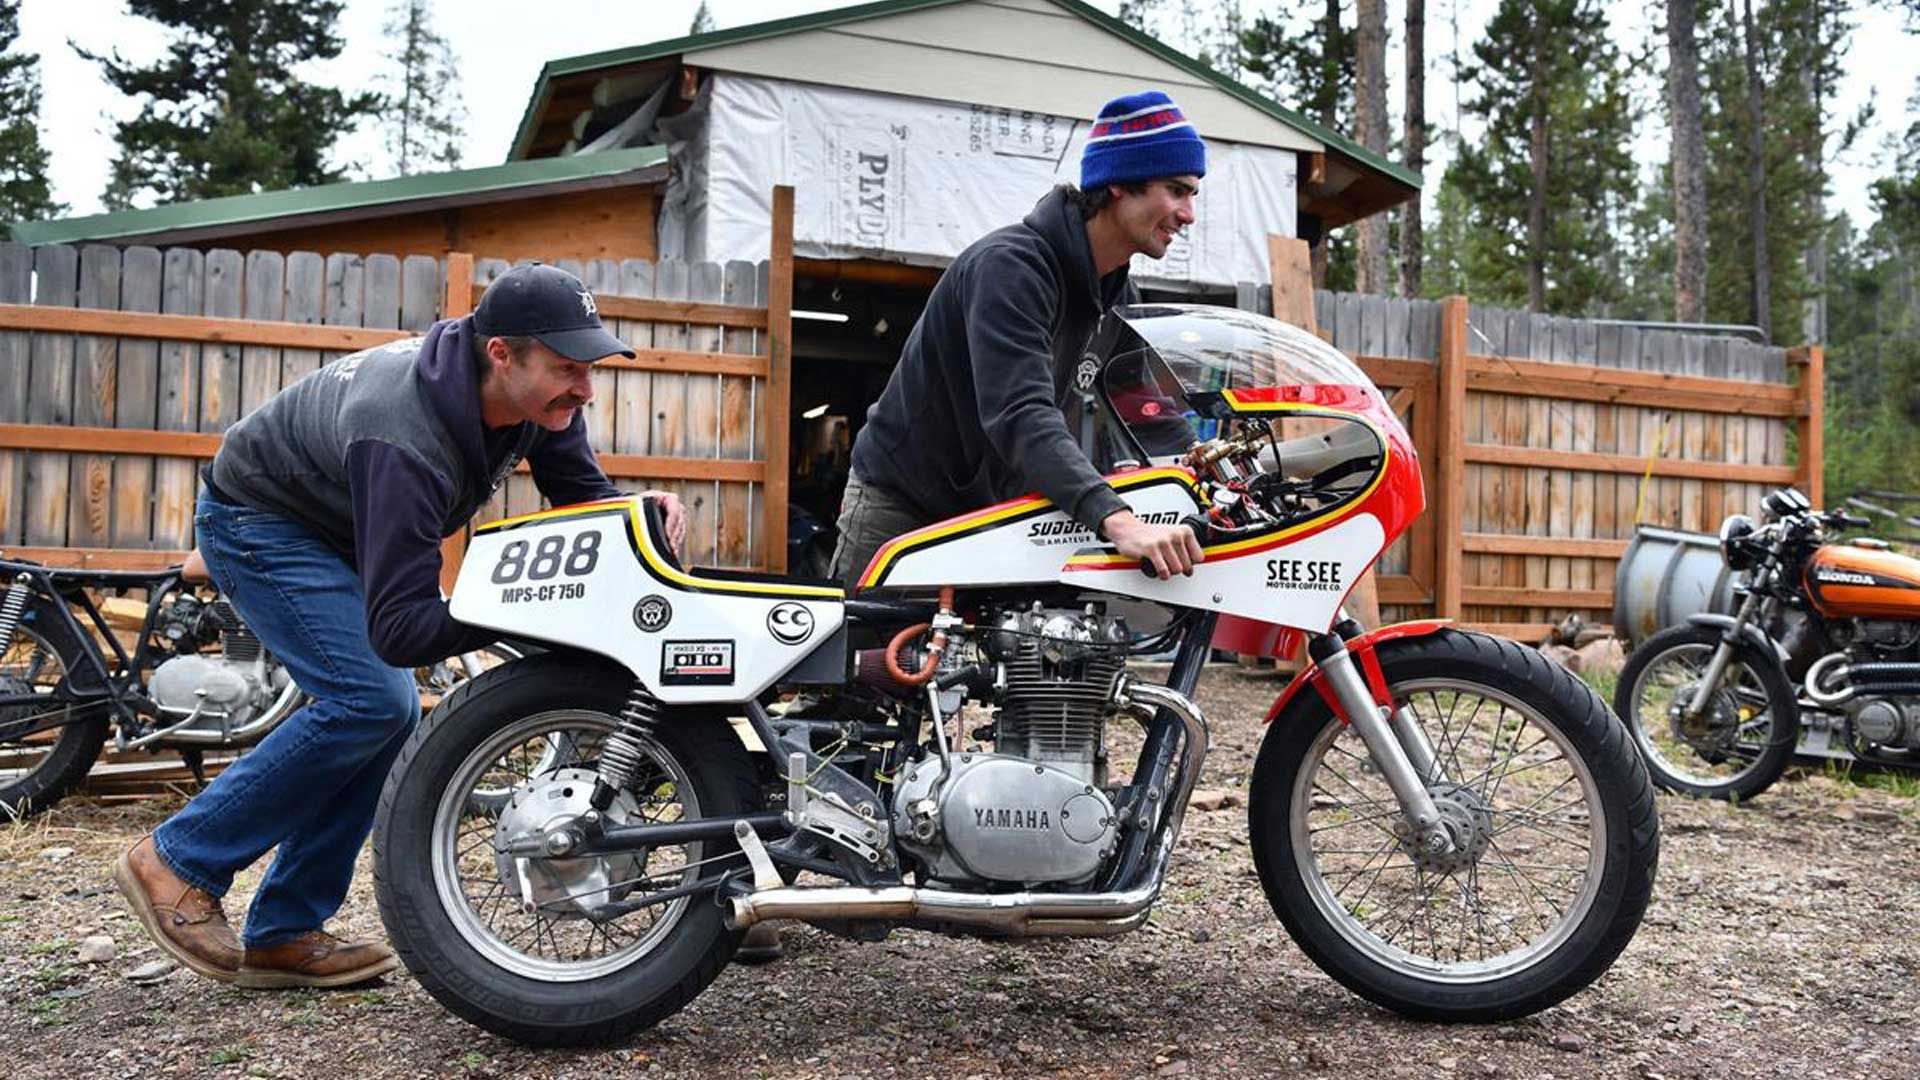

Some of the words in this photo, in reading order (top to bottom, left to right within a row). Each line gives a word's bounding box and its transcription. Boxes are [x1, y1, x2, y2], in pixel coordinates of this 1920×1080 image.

[1047, 536, 1090, 546] AMATEUR
[491, 530, 602, 584] 888
[1267, 560, 1302, 581] SEE
[1307, 561, 1341, 583] SEE
[1817, 572, 1876, 585] HONDA
[501, 585, 556, 604] MPS-CF
[558, 583, 585, 600] 750
[1266, 581, 1297, 589] MOTOR
[1298, 582, 1328, 591] COFFEE
[974, 808, 1050, 830] YAMAHA
